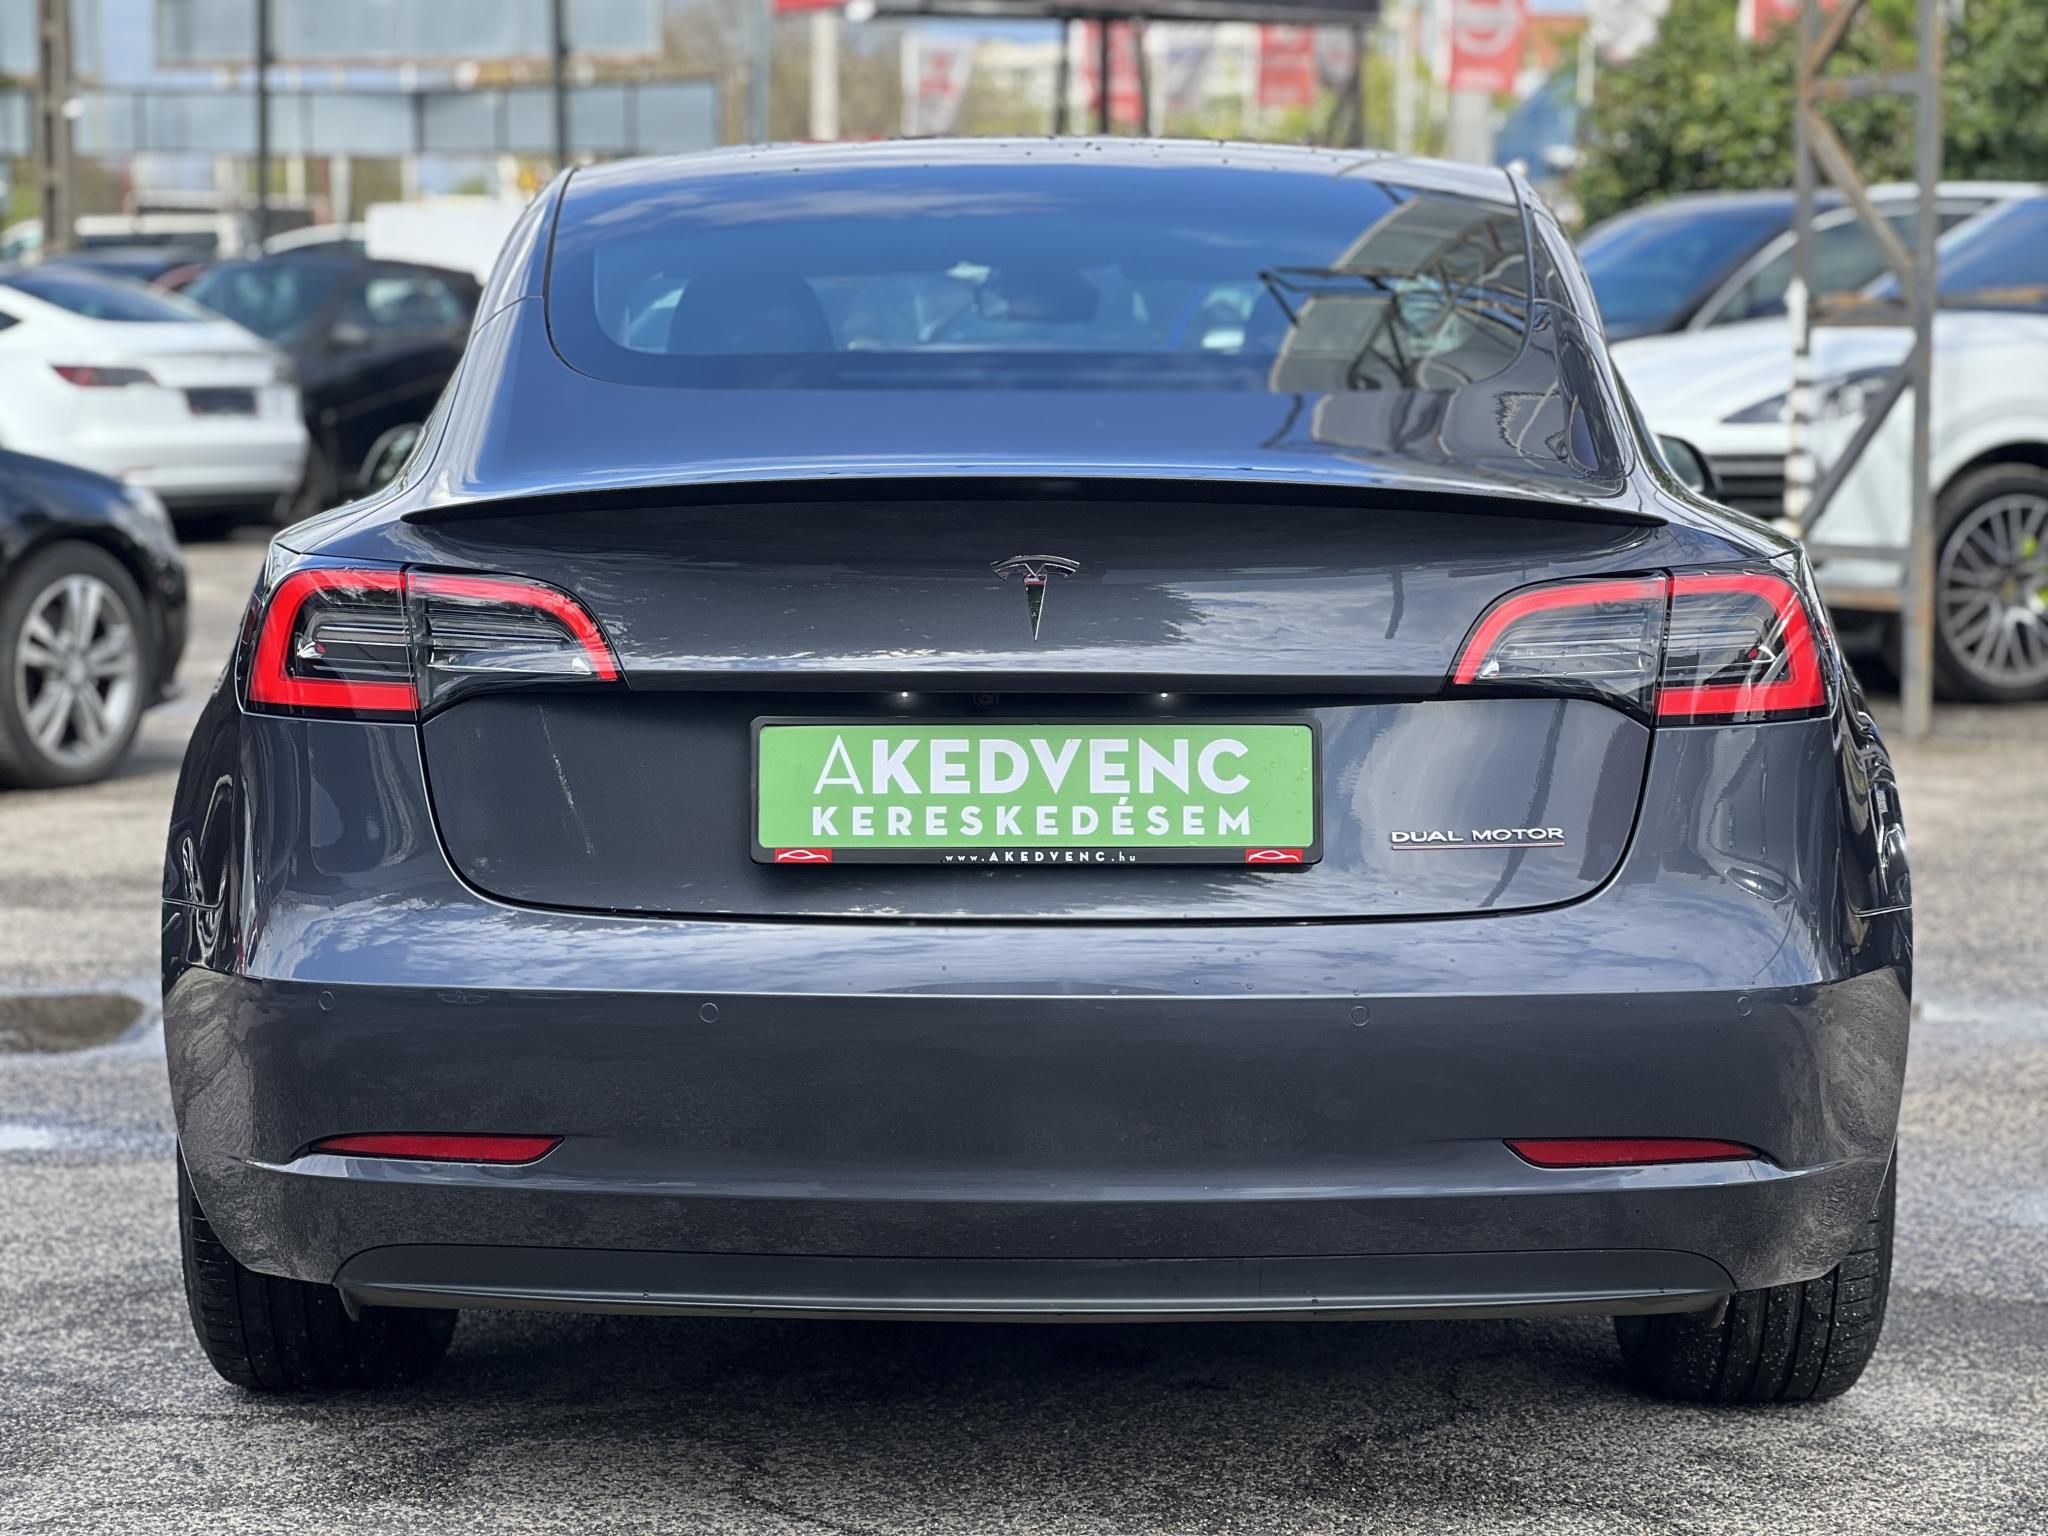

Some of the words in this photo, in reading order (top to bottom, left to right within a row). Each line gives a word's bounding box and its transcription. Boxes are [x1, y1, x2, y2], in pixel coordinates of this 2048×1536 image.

[811, 796, 1250, 836] KERESKEDÉSEM
[1391, 831, 1464, 843] DUAL
[1471, 828, 1565, 842] MOTOR
[944, 851, 1137, 863] www.AKEDVENC.hu
